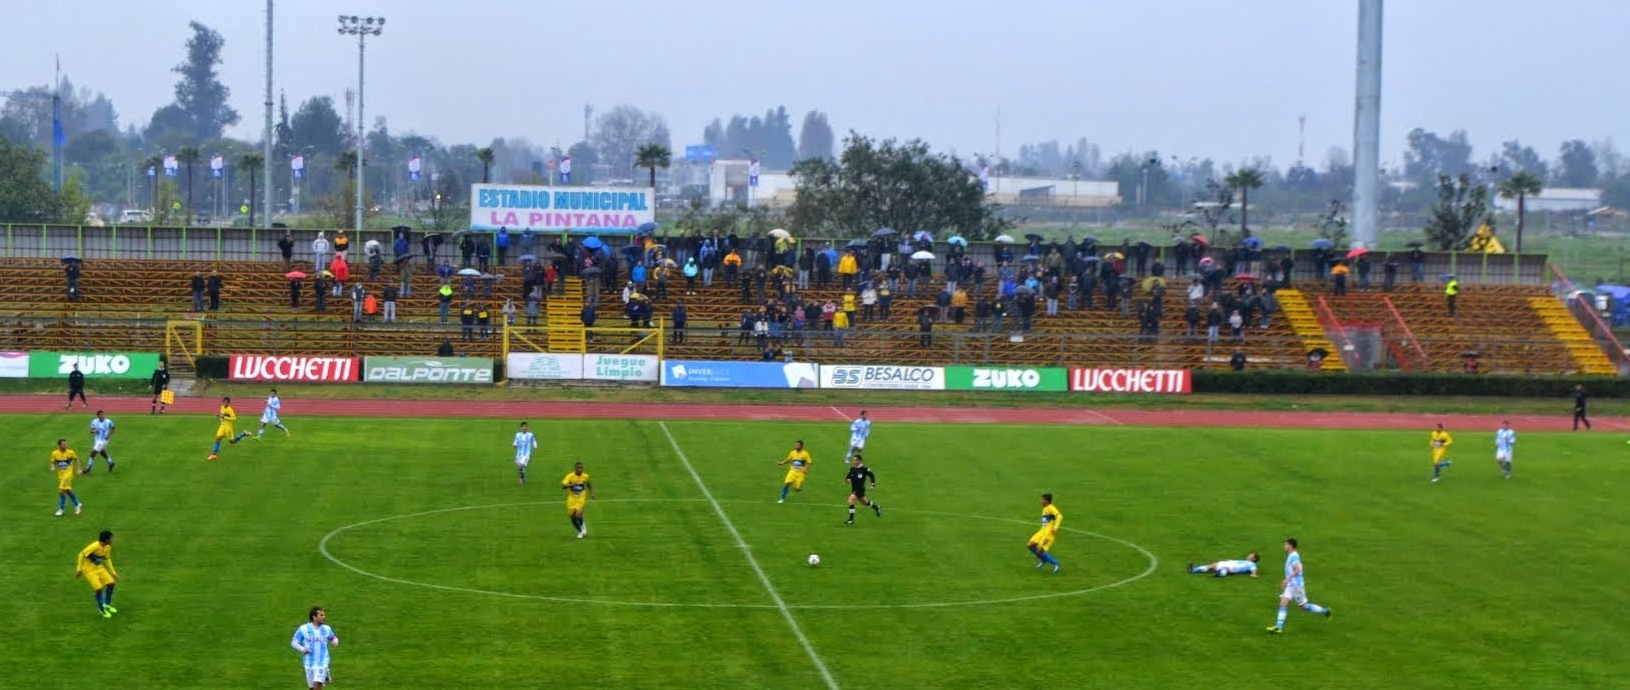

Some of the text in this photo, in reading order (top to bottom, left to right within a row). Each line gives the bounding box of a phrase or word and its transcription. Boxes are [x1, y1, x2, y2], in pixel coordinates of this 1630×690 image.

[479, 188, 648, 211] ESTADIO MUNICIPAL
[490, 211, 638, 228] LA PINTANA
[58, 354, 131, 375] ZUKO
[233, 356, 352, 381] LUCCHETTI
[596, 356, 646, 368] Juegue
[369, 367, 492, 382] DALPONTE
[596, 366, 643, 379] Limpio
[865, 367, 935, 382] BESALCO
[972, 368, 1041, 389] ZUKO
[1073, 369, 1184, 392] LUCCHETTI
